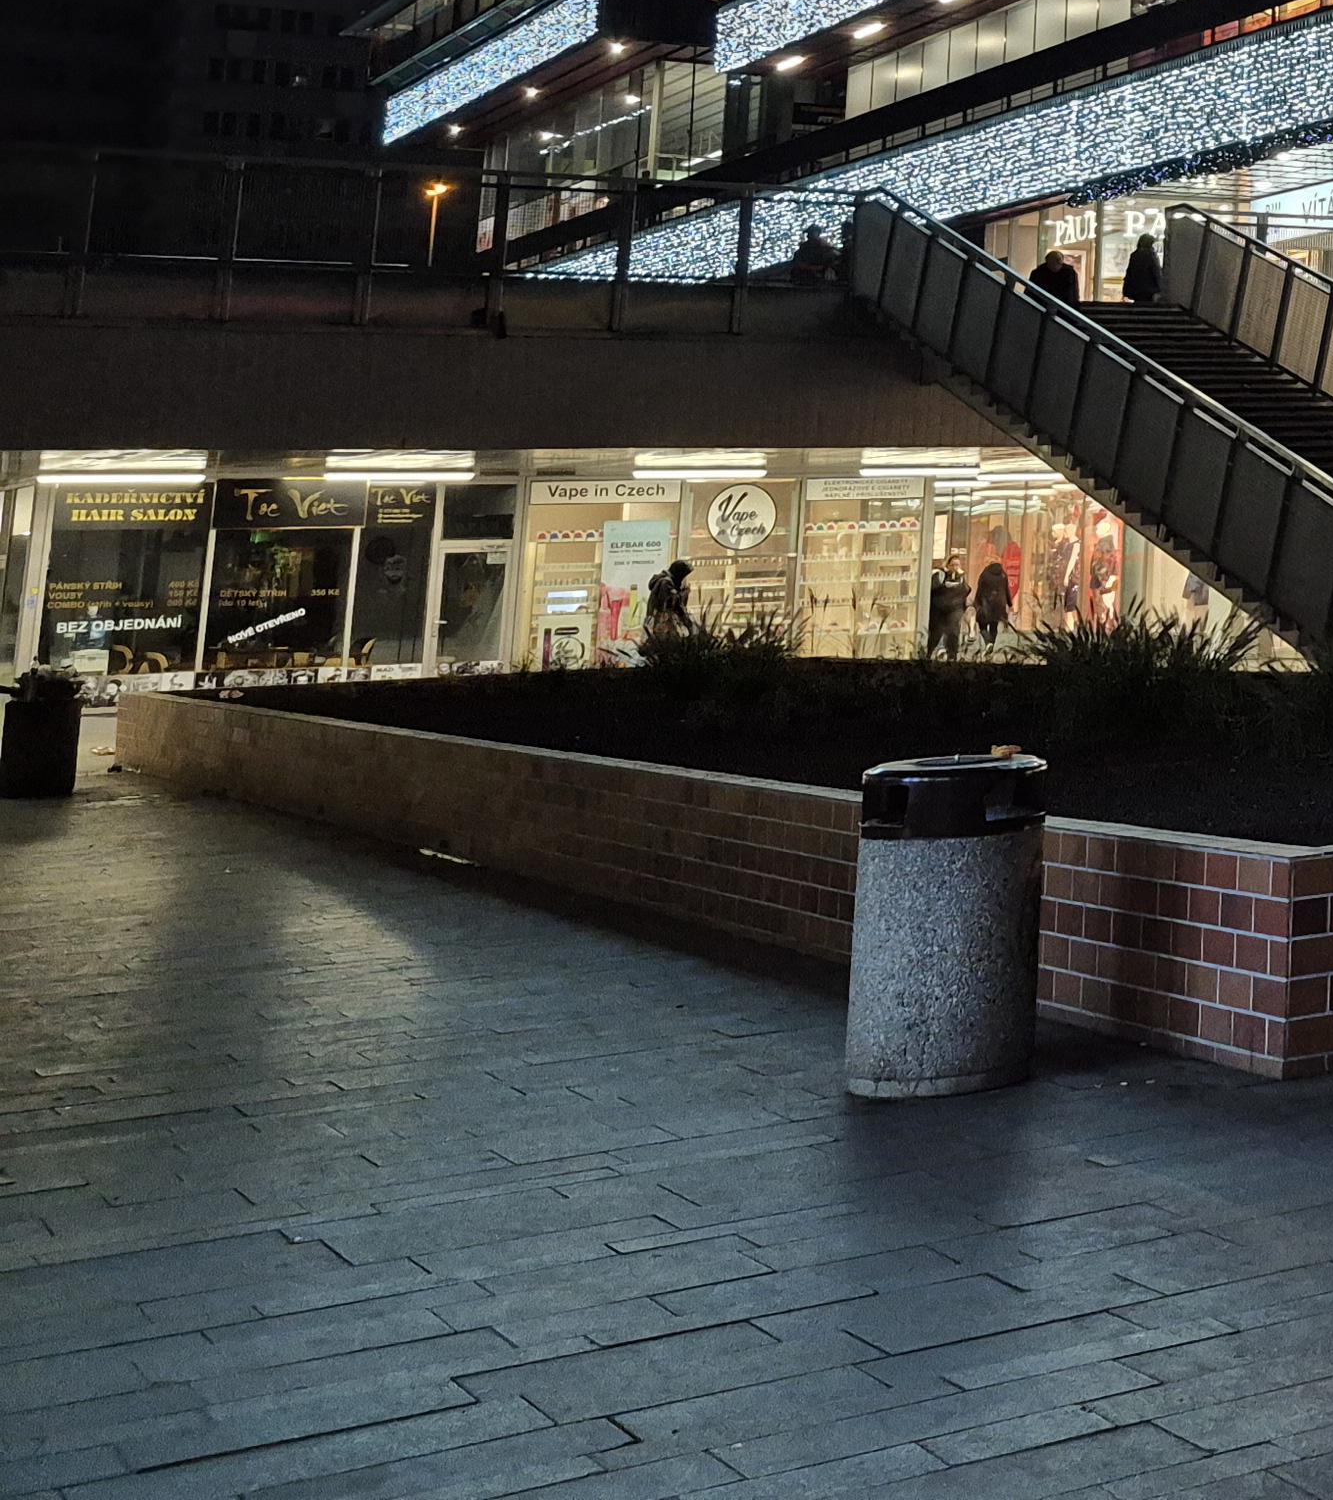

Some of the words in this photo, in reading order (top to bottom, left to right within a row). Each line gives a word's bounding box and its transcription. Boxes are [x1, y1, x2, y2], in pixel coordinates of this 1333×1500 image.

[65, 488, 206, 504] KADEŘNICTVÍ
[548, 484, 589, 500] Vape
[594, 484, 609, 497] in
[615, 483, 666, 498] Czech
[71, 509, 125, 522] HAIR
[130, 508, 198, 522] SALON
[718, 492, 758, 523] Vape
[729, 523, 767, 537] Czech
[610, 541, 644, 549] ELFBAR
[48, 592, 83, 600] VOUSY
[47, 601, 85, 609] COMBO
[56, 620, 88, 633] BEZ
[90, 614, 183, 632] OBJEDNÁNÍ
[227, 625, 256, 644] NOVĚ
[255, 606, 307, 634] OTEVŘENO
